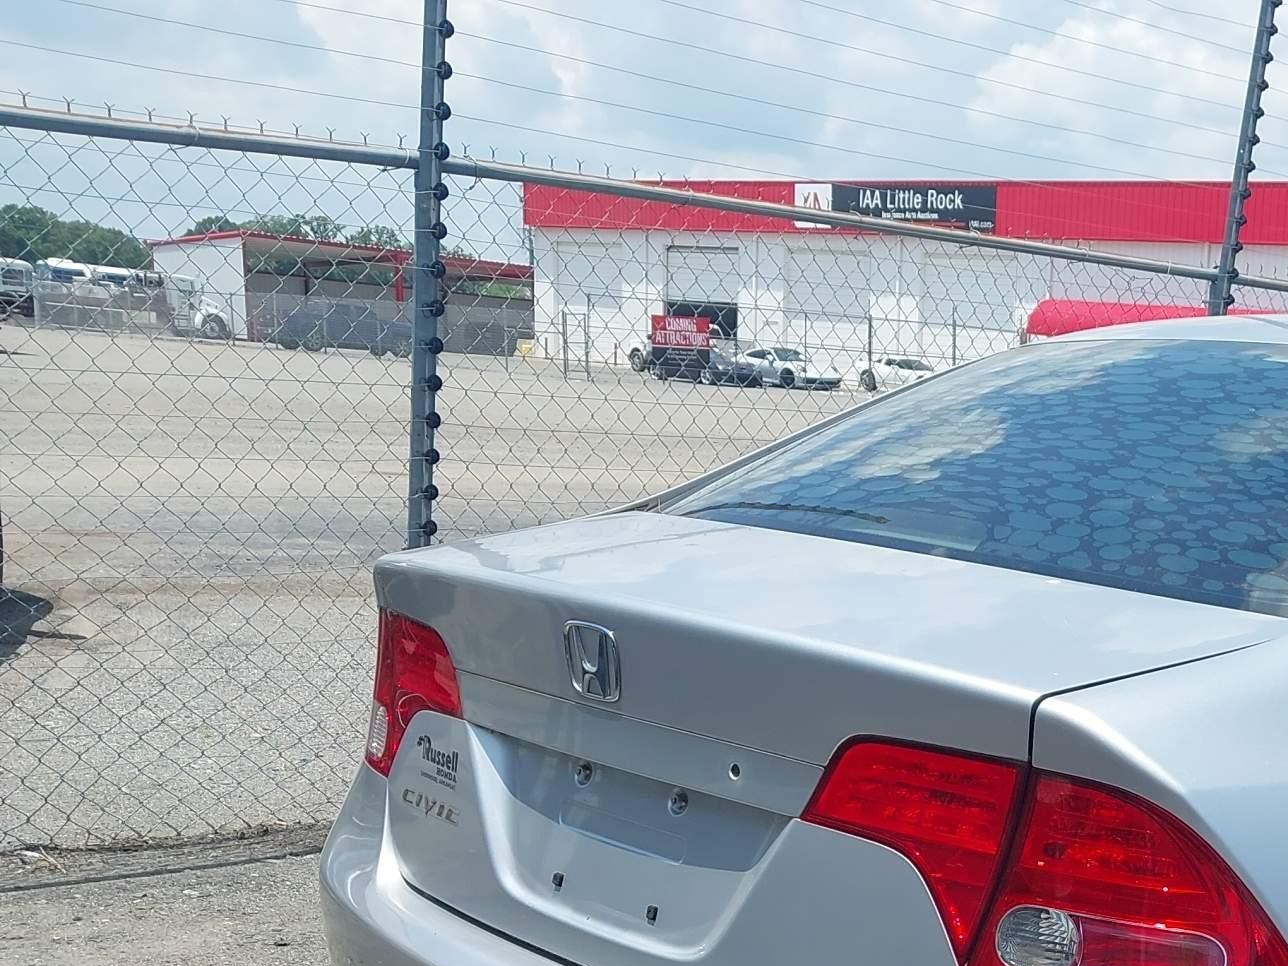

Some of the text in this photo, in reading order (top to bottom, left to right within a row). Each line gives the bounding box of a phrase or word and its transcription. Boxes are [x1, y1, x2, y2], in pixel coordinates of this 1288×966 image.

[859, 189, 964, 209] IAA Little Rock
[881, 211, 905, 219] Insuance
[665, 317, 697, 332] COMING
[655, 331, 709, 346] ATTRACTIONS
[417, 735, 459, 773] Russell
[436, 767, 457, 783] HONDA
[402, 788, 459, 824] CIVIC
